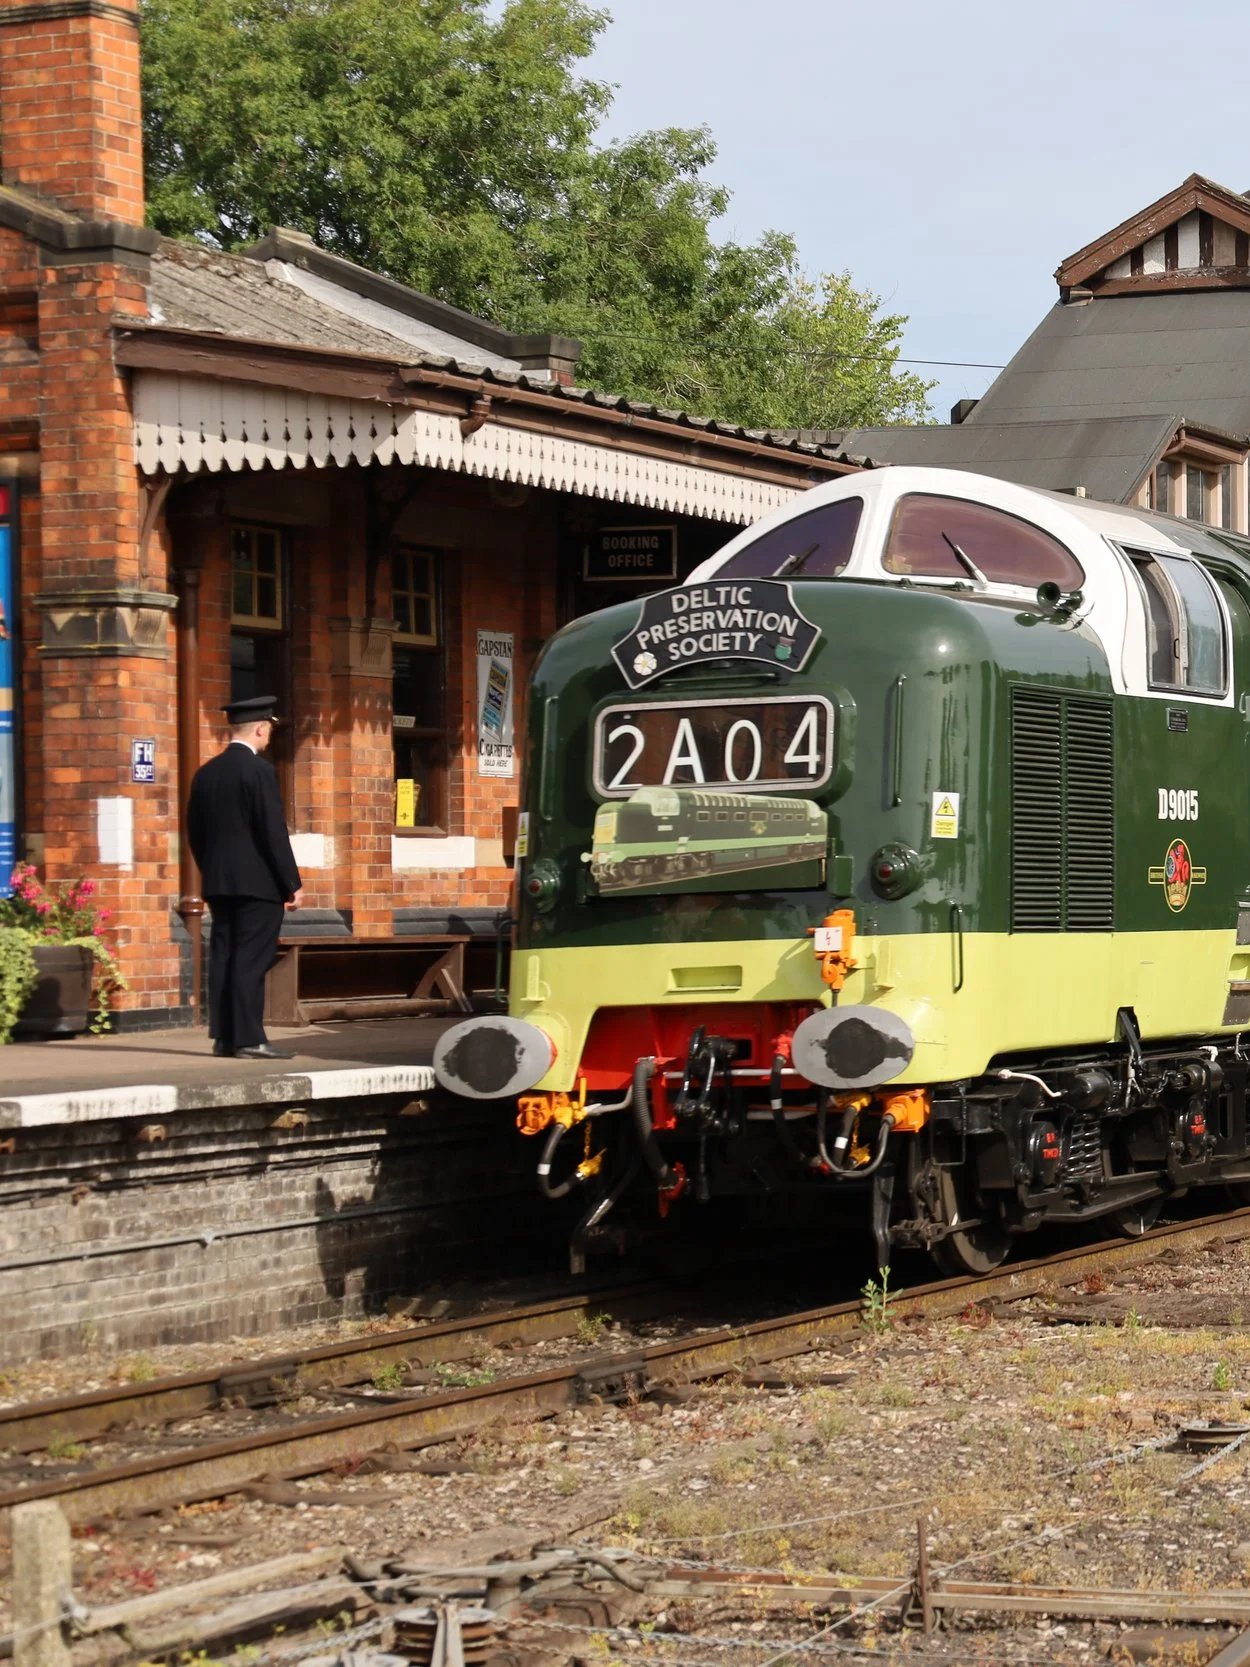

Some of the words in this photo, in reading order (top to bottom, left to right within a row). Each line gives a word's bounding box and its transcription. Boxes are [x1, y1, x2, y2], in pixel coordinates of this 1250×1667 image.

[602, 536, 660, 550] BOOKING
[608, 554, 654, 568] OFFICE
[671, 586, 752, 613] DELTIC
[636, 608, 799, 650] PRESERVATION
[478, 639, 512, 658] CAPSTAN
[668, 632, 763, 661] SOCIETY
[135, 742, 153, 763] FH
[1158, 788, 1199, 821] D9015
